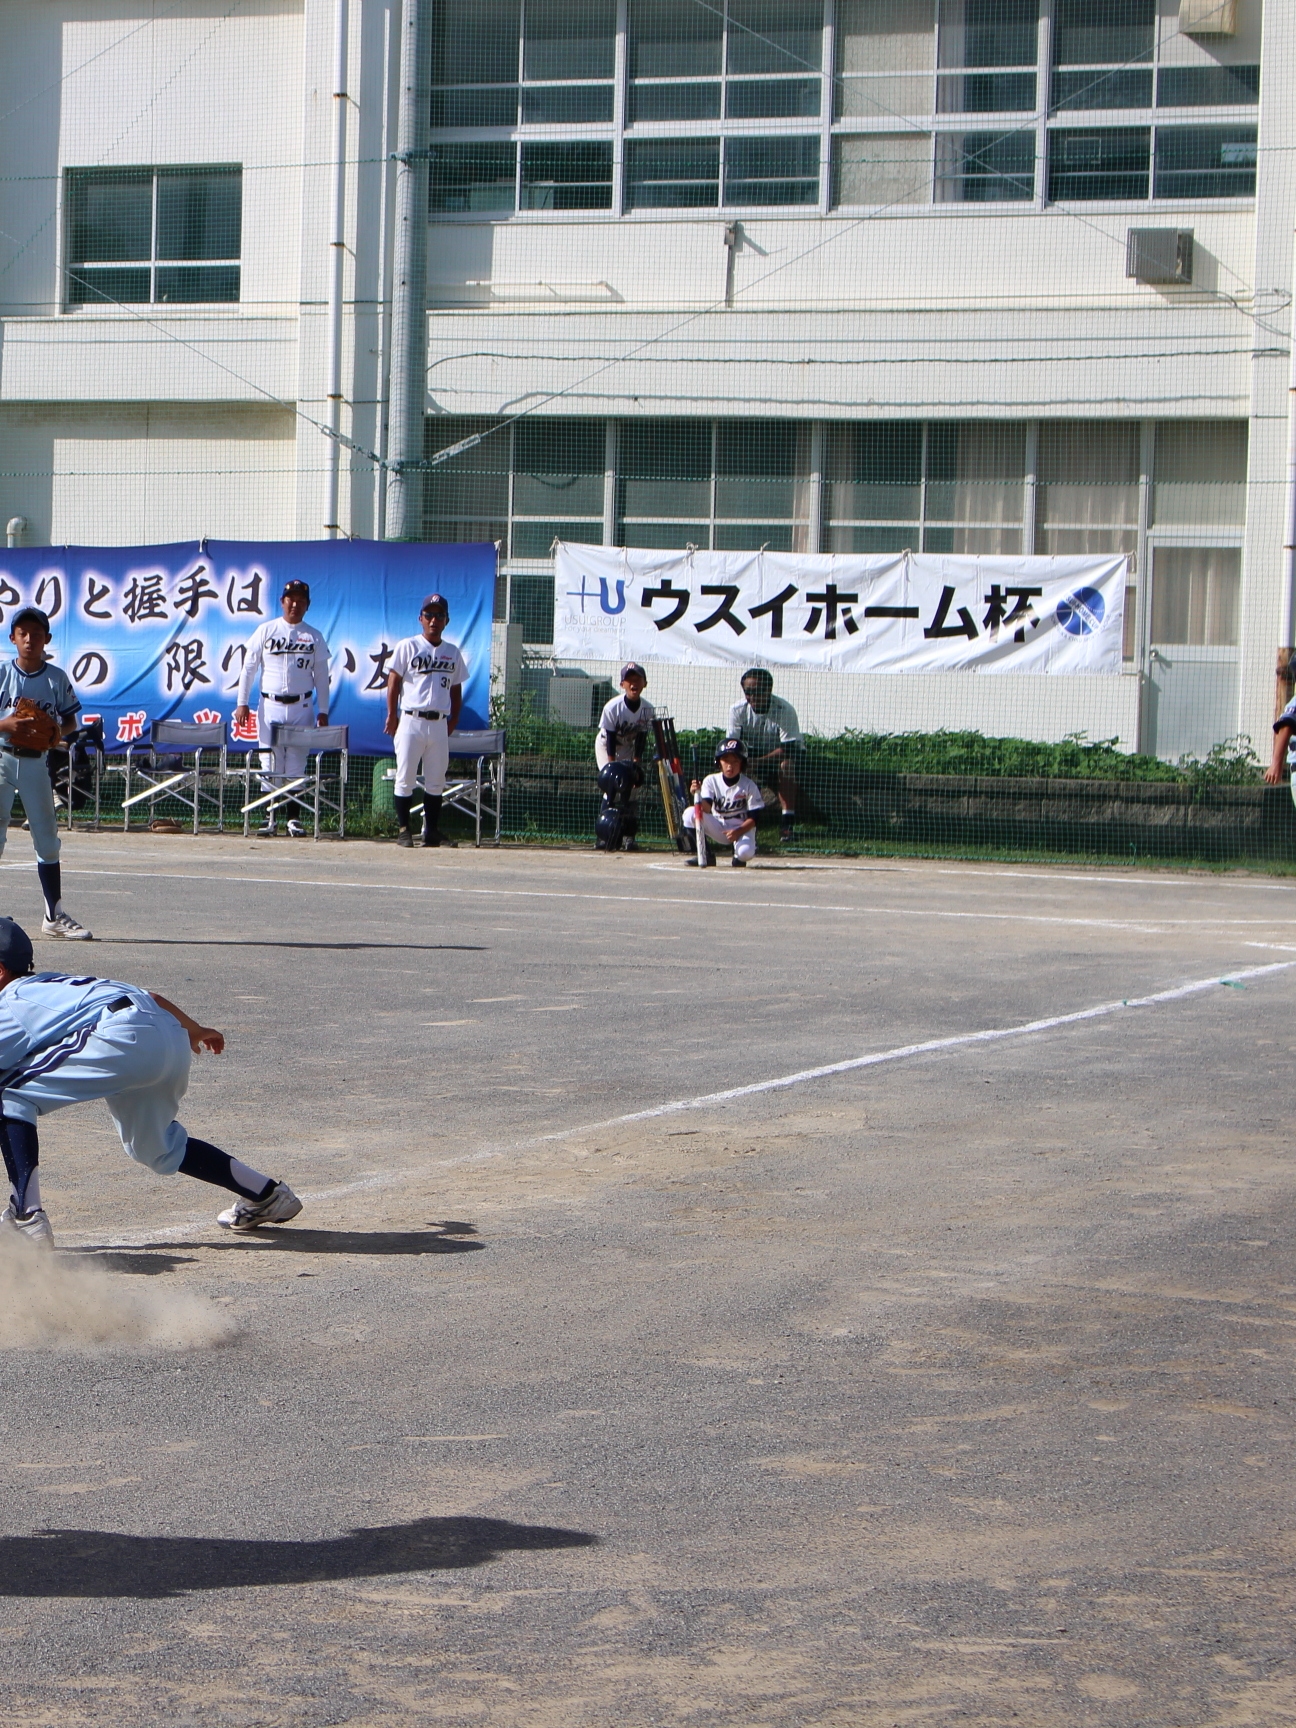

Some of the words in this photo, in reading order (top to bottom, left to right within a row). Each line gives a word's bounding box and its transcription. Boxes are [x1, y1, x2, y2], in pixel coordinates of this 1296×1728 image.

[640, 578, 1043, 643] ウスイホーム杯
[264, 637, 315, 655] Wins
[411, 654, 455, 674] Wins
